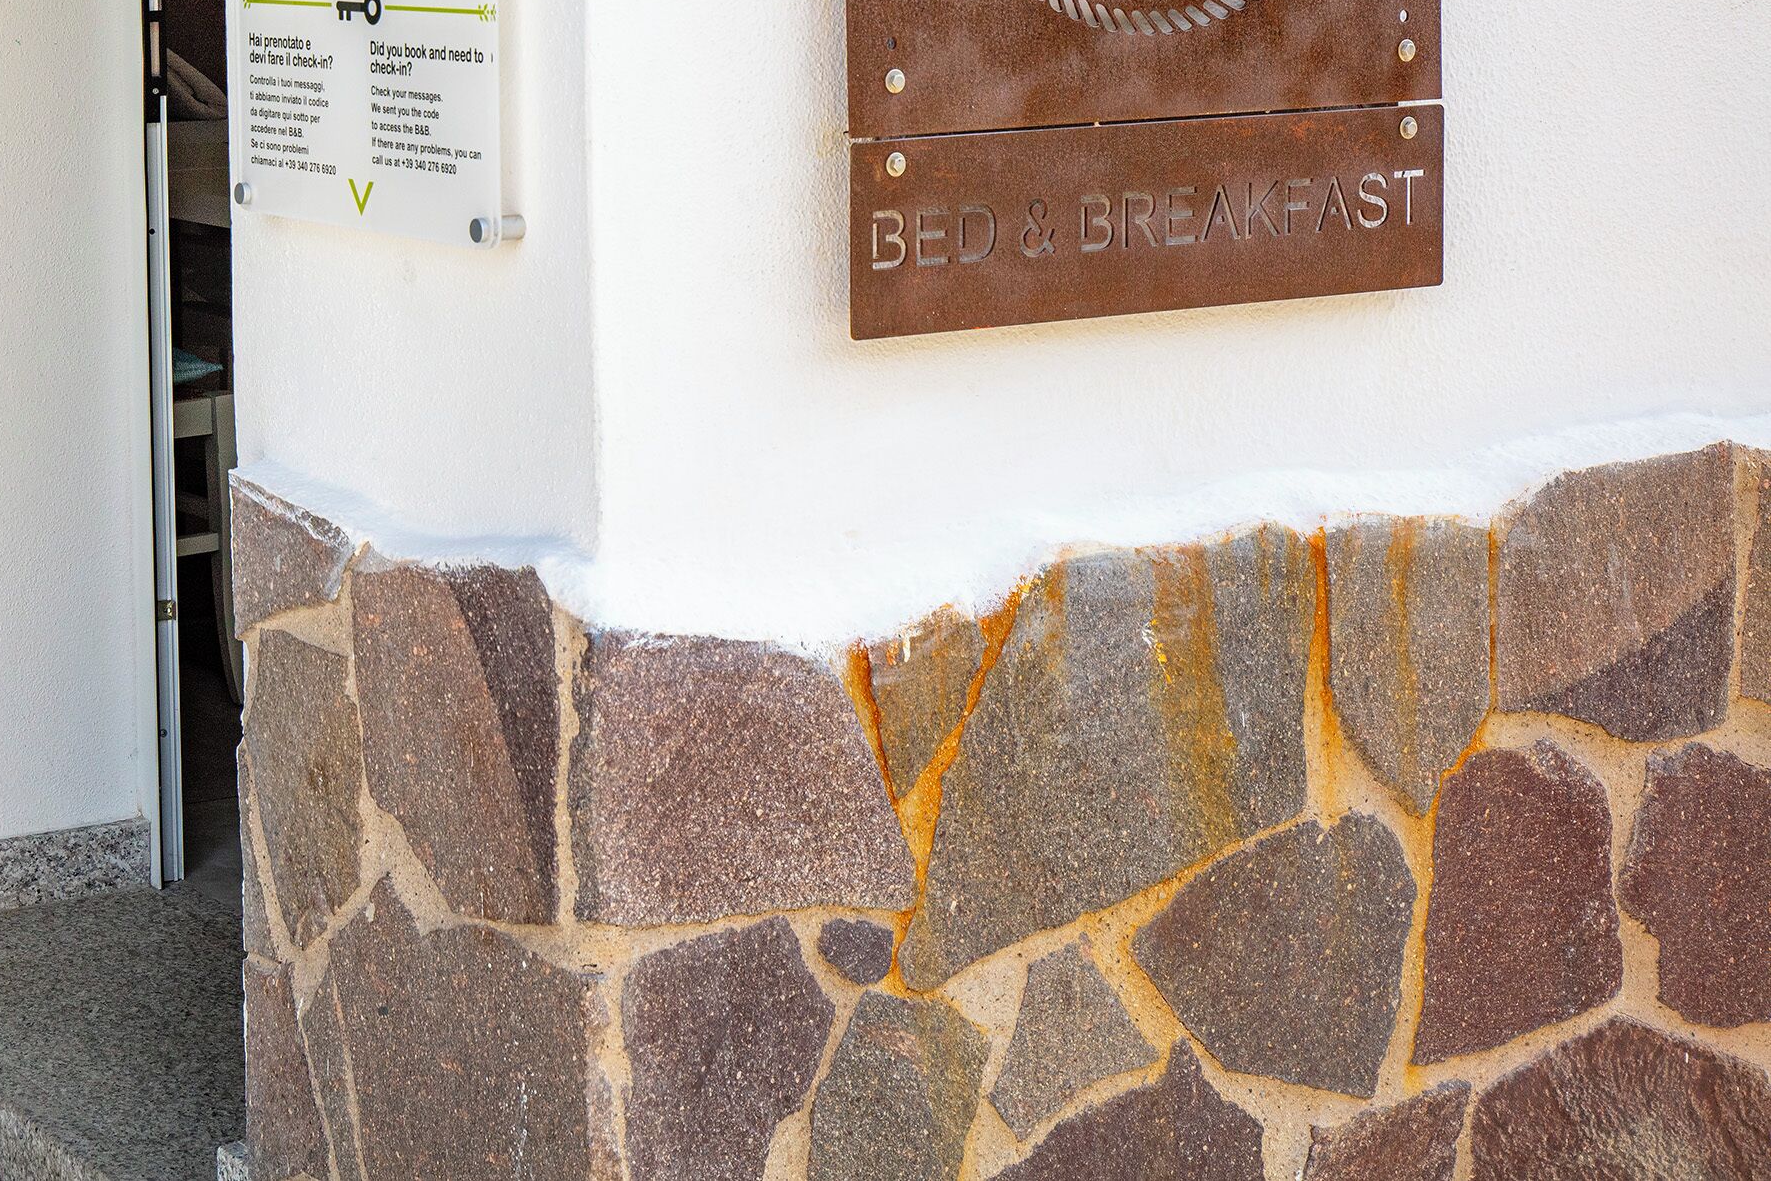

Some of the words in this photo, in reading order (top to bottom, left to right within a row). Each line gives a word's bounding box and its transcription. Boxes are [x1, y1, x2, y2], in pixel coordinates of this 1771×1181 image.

[249, 32, 262, 47] Hai
[264, 36, 304, 50] prenotato
[306, 40, 311, 50] e
[250, 50, 266, 64] devi
[268, 51, 284, 66] fare
[286, 52, 291, 66] il
[293, 53, 333, 69] check-in?
[370, 41, 384, 56] Did
[387, 45, 402, 60] you
[405, 43, 427, 59] book
[429, 45, 446, 61] and
[449, 47, 472, 62] need
[475, 48, 484, 64] to
[370, 59, 412, 76] check-in?
[250, 74, 276, 86] Controlla
[281, 78, 292, 88] tuoi
[250, 91, 254, 100] ti
[255, 92, 280, 103] abbiamo
[282, 94, 302, 105] inviato
[303, 95, 307, 105] il
[309, 96, 329, 108] codice
[371, 85, 390, 97] Check
[392, 90, 407, 100] your
[250, 107, 257, 117] da
[259, 108, 281, 120] digitare
[282, 111, 292, 121] qui
[293, 113, 309, 122] sotto
[310, 115, 320, 125] per
[371, 103, 381, 113] We
[382, 106, 397, 115] sent
[398, 107, 410, 118] you
[411, 107, 422, 118] the
[423, 109, 439, 120] code
[251, 124, 277, 134] accedere
[278, 127, 287, 136] nel
[289, 127, 304, 138] B&B.
[372, 121, 378, 130] to
[380, 123, 401, 133] access
[403, 124, 413, 134] the
[415, 124, 432, 136] B&B.
[251, 138, 258, 148] Se
[260, 140, 265, 149] ci
[266, 142, 281, 152] sono
[283, 144, 309, 155] problemi
[372, 137, 377, 147] If
[378, 138, 394, 149] there
[395, 141, 405, 150] are
[407, 143, 419, 155] any
[420, 144, 453, 158] problems,
[455, 149, 467, 160] you
[469, 151, 482, 160] can
[251, 155, 277, 167] chiamaci
[278, 159, 284, 168] al
[285, 160, 296, 169] +39
[297, 161, 308, 171] 340
[309, 162, 320, 173] 276
[322, 164, 337, 175] 6920
[372, 155, 383, 165] call
[384, 158, 393, 167] us
[394, 159, 400, 168] at
[402, 158, 413, 169] +39
[415, 160, 426, 171] 340
[428, 161, 439, 172] 276
[441, 163, 456, 175] 6920
[870, 203, 997, 271] BED
[1020, 198, 1056, 258] &
[1080, 169, 1426, 254] BREAKFAST
